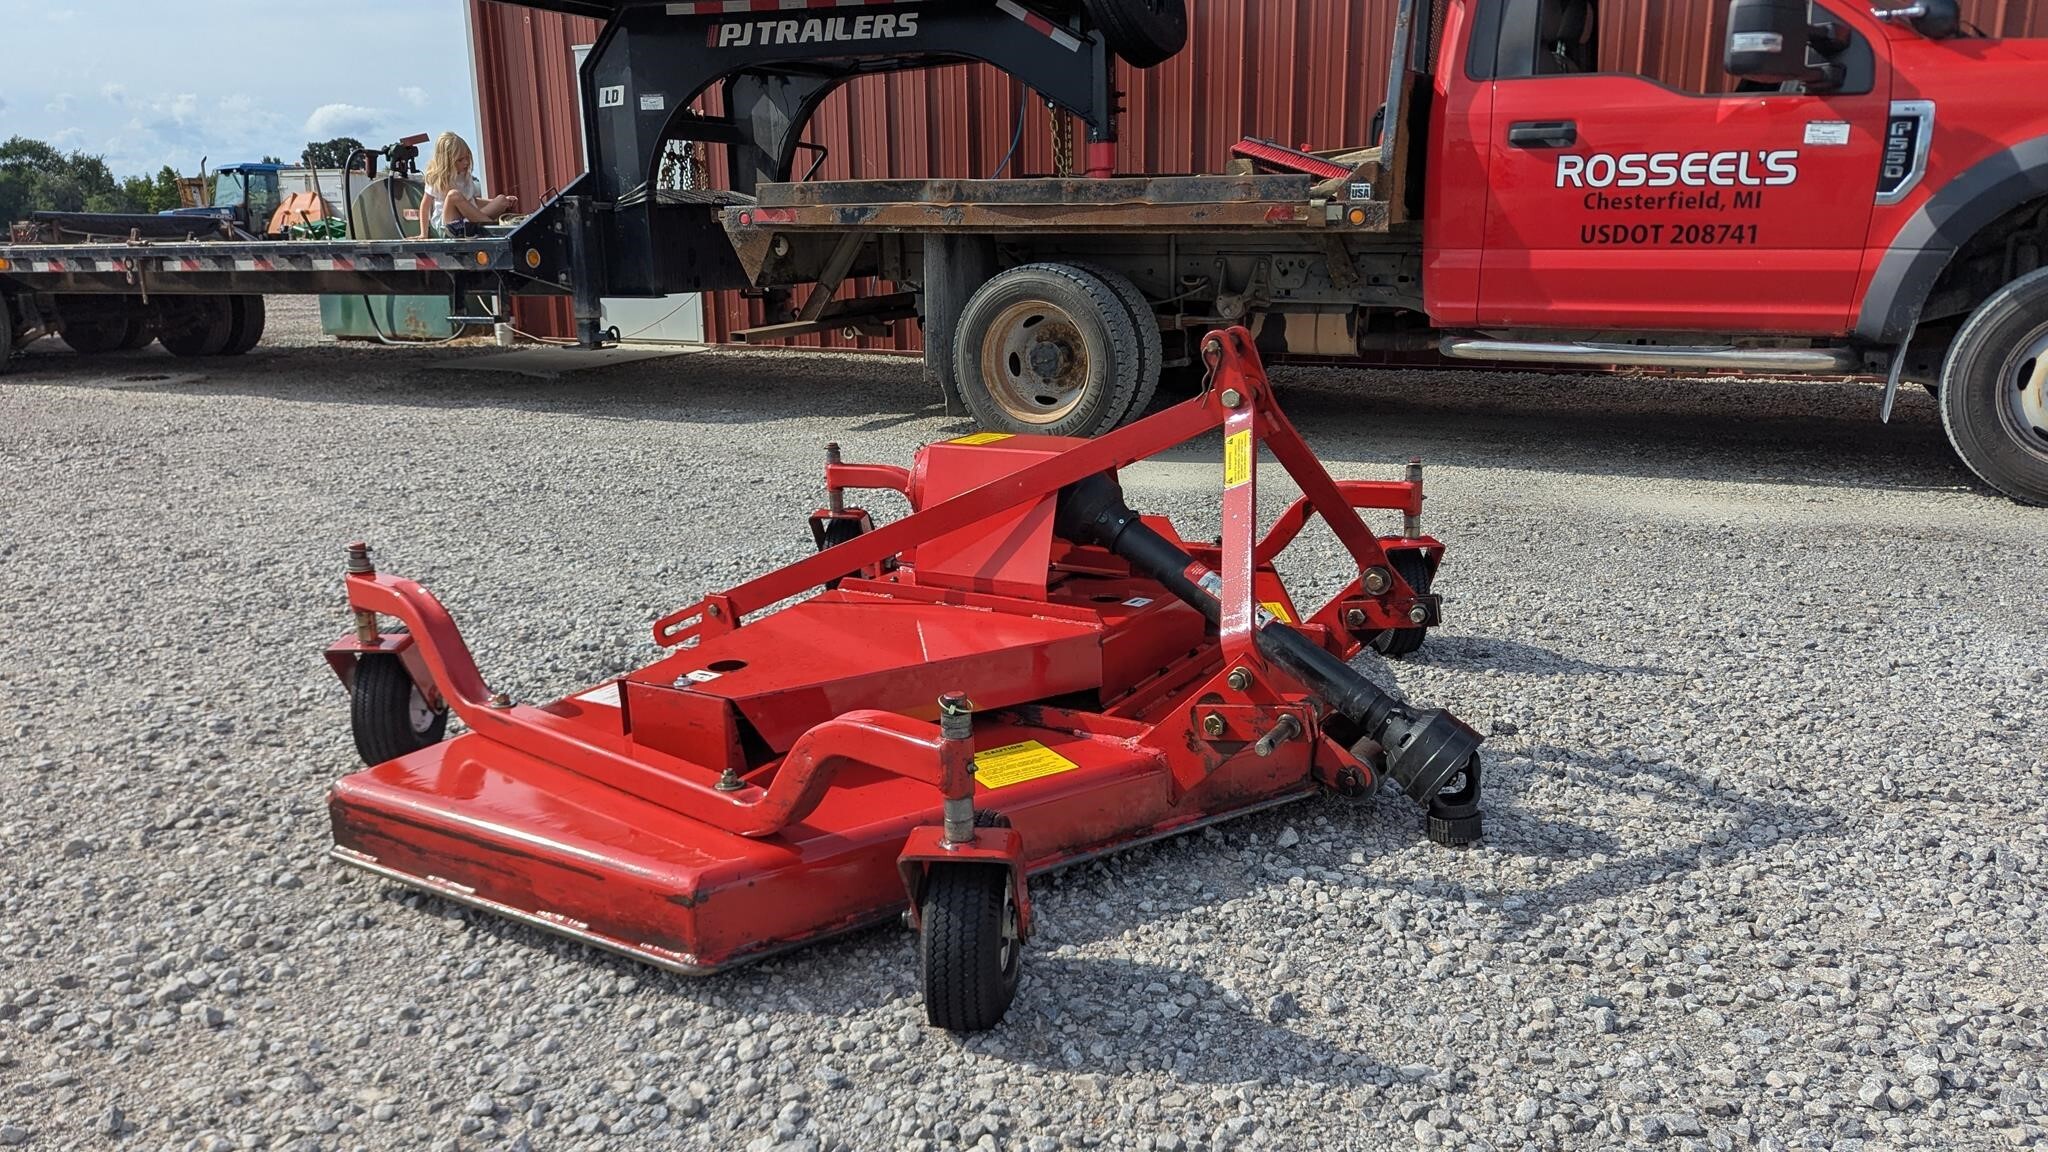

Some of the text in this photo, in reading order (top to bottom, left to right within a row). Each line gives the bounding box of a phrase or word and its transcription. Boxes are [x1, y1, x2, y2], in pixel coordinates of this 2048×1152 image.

[718, 12, 919, 48] PJ TRAILERS
[604, 88, 620, 105] LD
[1884, 121, 1912, 178] F550
[1556, 151, 1799, 187] ROSSEEL'S
[1352, 189, 1369, 198] USA
[1583, 190, 1762, 212] Chesterfield, MI
[1580, 223, 1759, 245] USDOT 208741
[983, 744, 1024, 756] CAUTION
